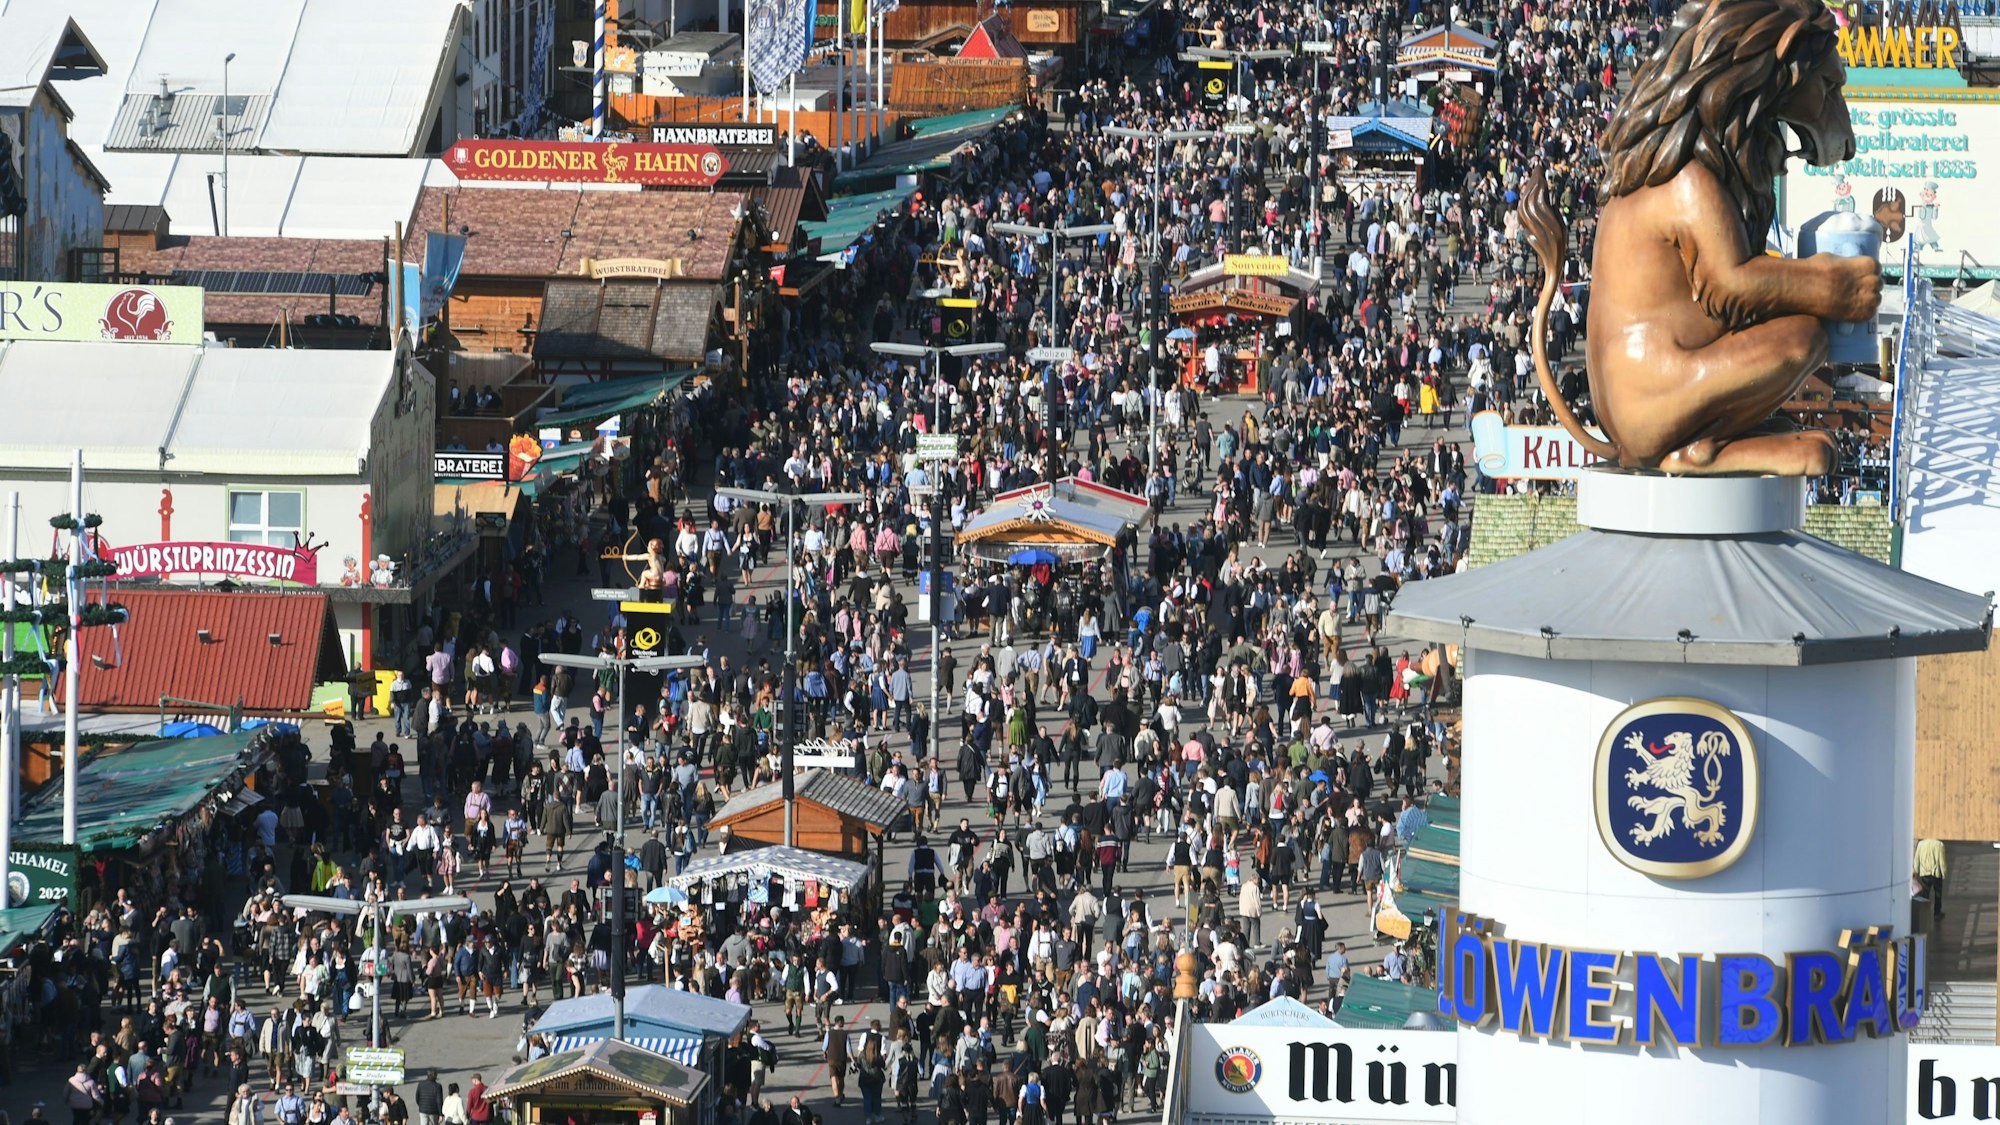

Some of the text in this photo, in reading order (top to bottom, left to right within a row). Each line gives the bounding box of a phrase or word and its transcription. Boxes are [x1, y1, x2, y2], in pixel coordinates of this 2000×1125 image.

[1878, 108, 1957, 129] grösste
[652, 127, 773, 145] HAXNBRATEREI
[474, 148, 598, 171] GOLDENER
[634, 151, 699, 173] HAHN
[1888, 158, 1929, 177] seit
[1932, 160, 1978, 179] 1885
[595, 265, 667, 276] WURSTBRATEREI
[1231, 260, 1281, 271] Souvenirs
[1171, 298, 1217, 311] Souvenirs
[1231, 298, 1282, 313] Andenken
[1038, 350, 1069, 358] Polizei
[434, 459, 503, 473] BRATEREI
[1437, 904, 1928, 1049] LÖWENBRÄU
[1260, 1008, 1310, 1022] BURTSCHERS
[1218, 1047, 1260, 1066] PAULANER
[1222, 1079, 1256, 1092] MÜNCHEN
